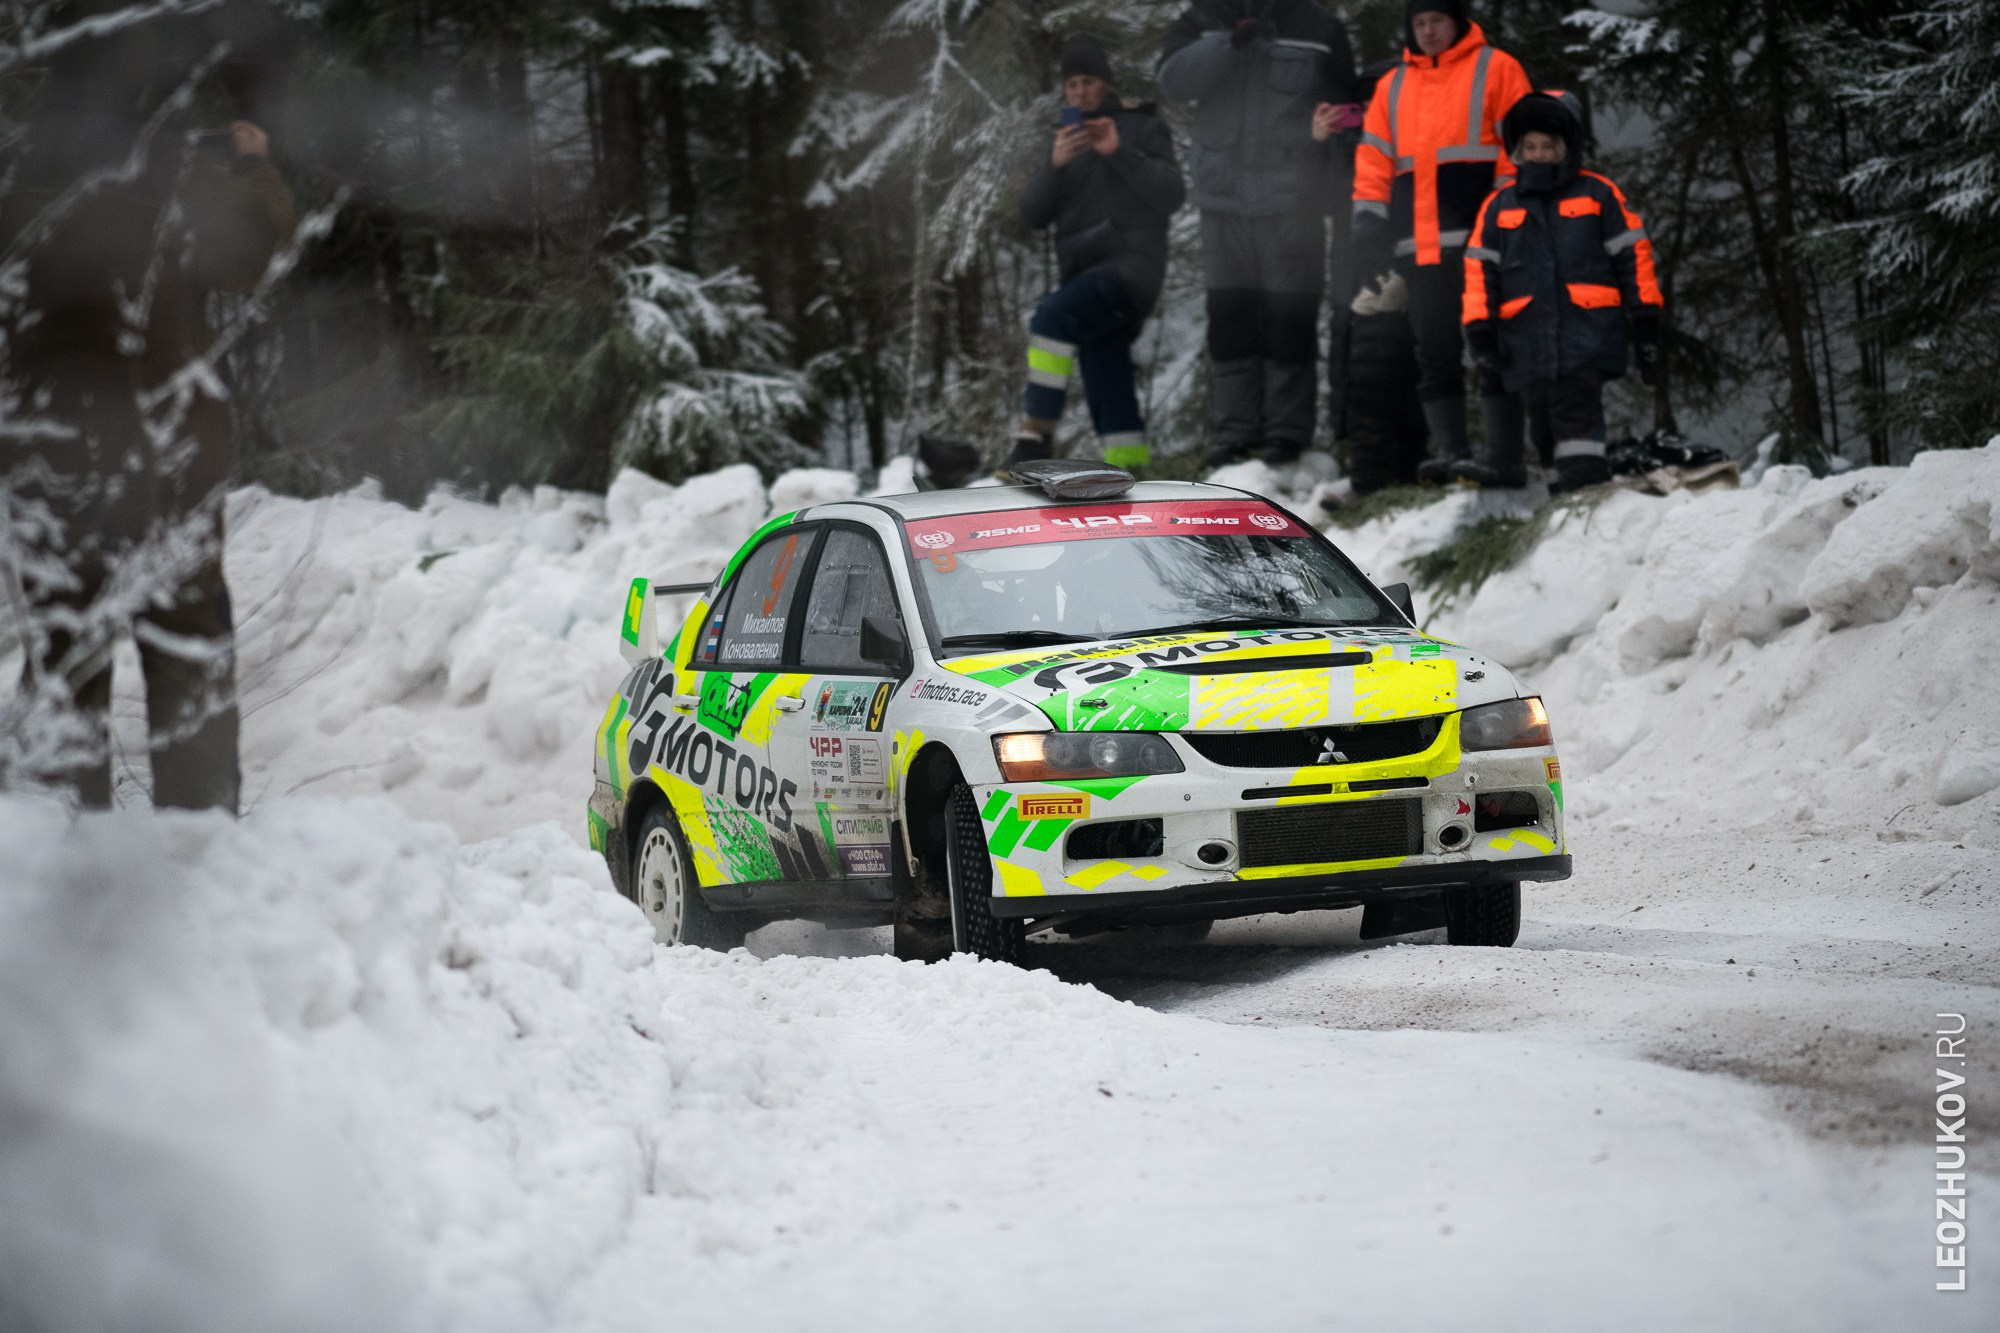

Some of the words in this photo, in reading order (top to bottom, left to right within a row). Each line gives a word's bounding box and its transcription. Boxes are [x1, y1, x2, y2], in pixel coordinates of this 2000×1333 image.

[930, 549, 958, 573] 9
[762, 533, 798, 618] 9
[741, 613, 785, 634] Михайлов
[722, 639, 779, 660] Коноваленко
[1135, 628, 1412, 668] MOTORS
[870, 683, 889, 731] 9
[810, 736, 842, 757] ЧРР
[655, 715, 798, 833] MOTORS
[1022, 797, 1083, 816] PIRELLI
[836, 815, 884, 837] СИТИДРАЙВ
